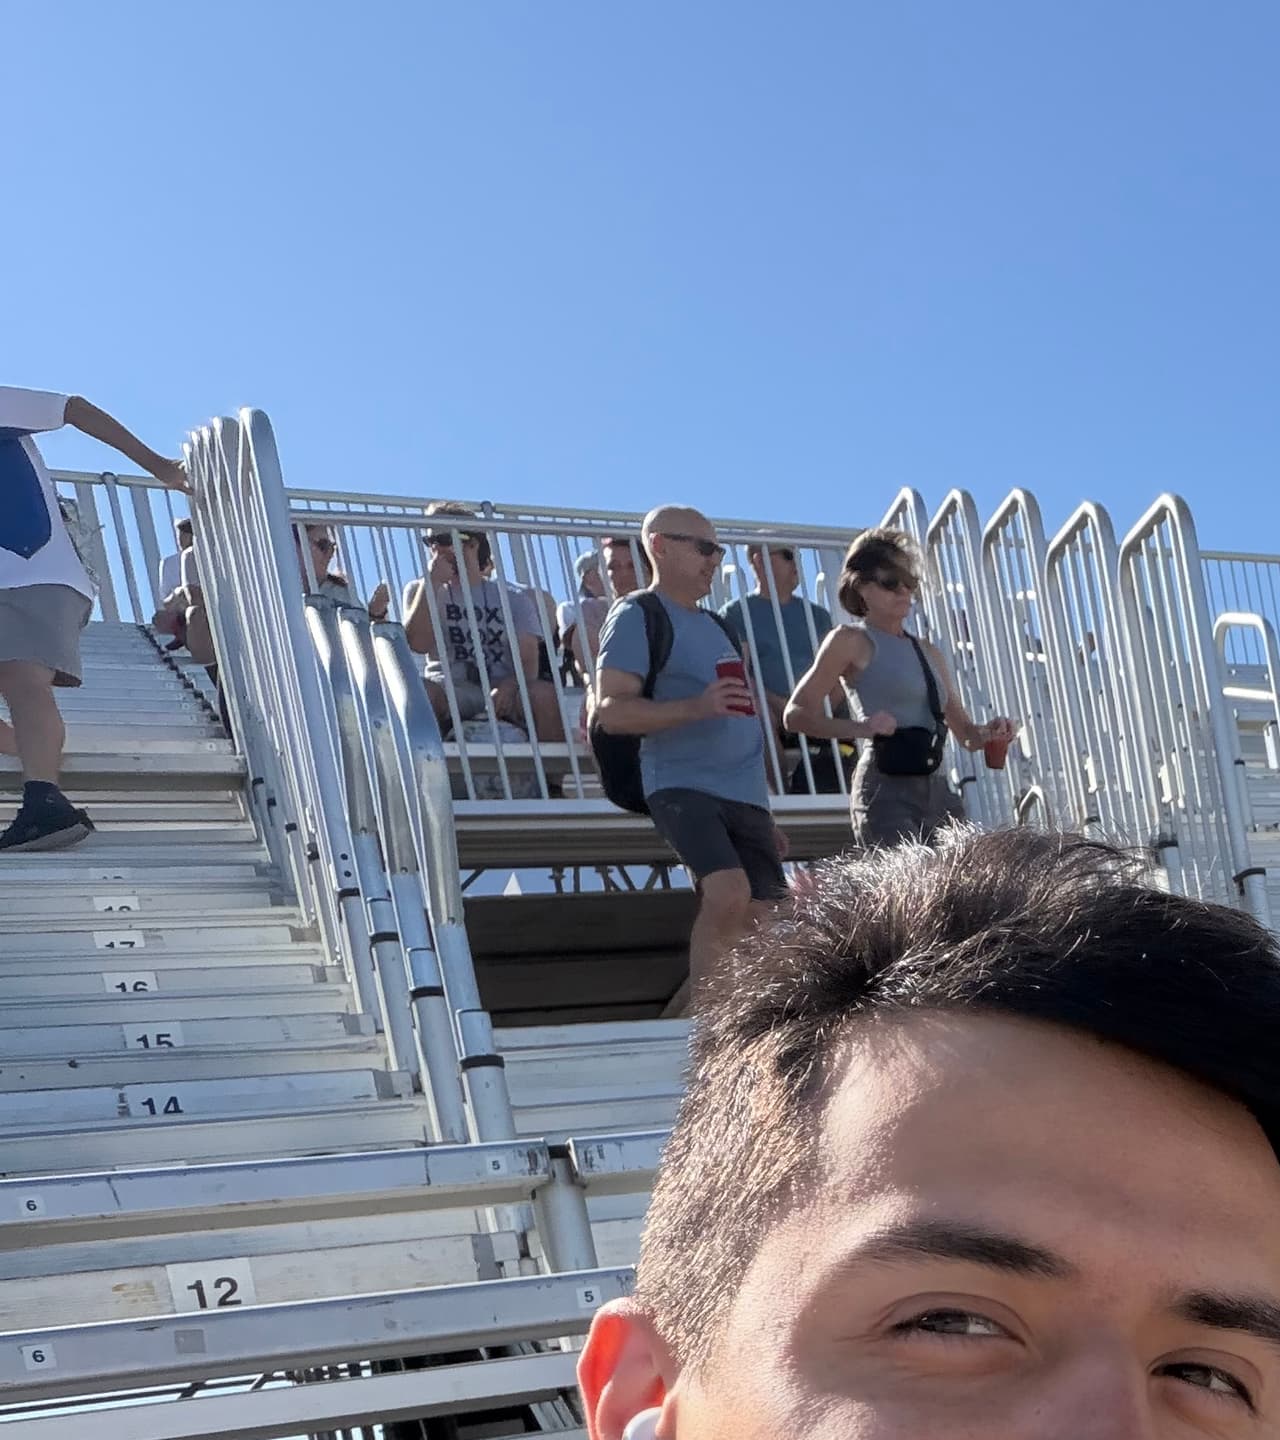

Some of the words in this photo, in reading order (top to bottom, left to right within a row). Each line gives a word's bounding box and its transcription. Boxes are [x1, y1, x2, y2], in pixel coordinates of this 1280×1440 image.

[446, 604, 504, 622] BOX
[136, 1033, 175, 1049] 15
[141, 1096, 184, 1116] 14
[491, 1160, 501, 1171] 5
[25, 1199, 38, 1212] 6
[186, 1276, 243, 1310] 12
[583, 1290, 595, 1303] 5
[32, 1349, 46, 1364] 6
